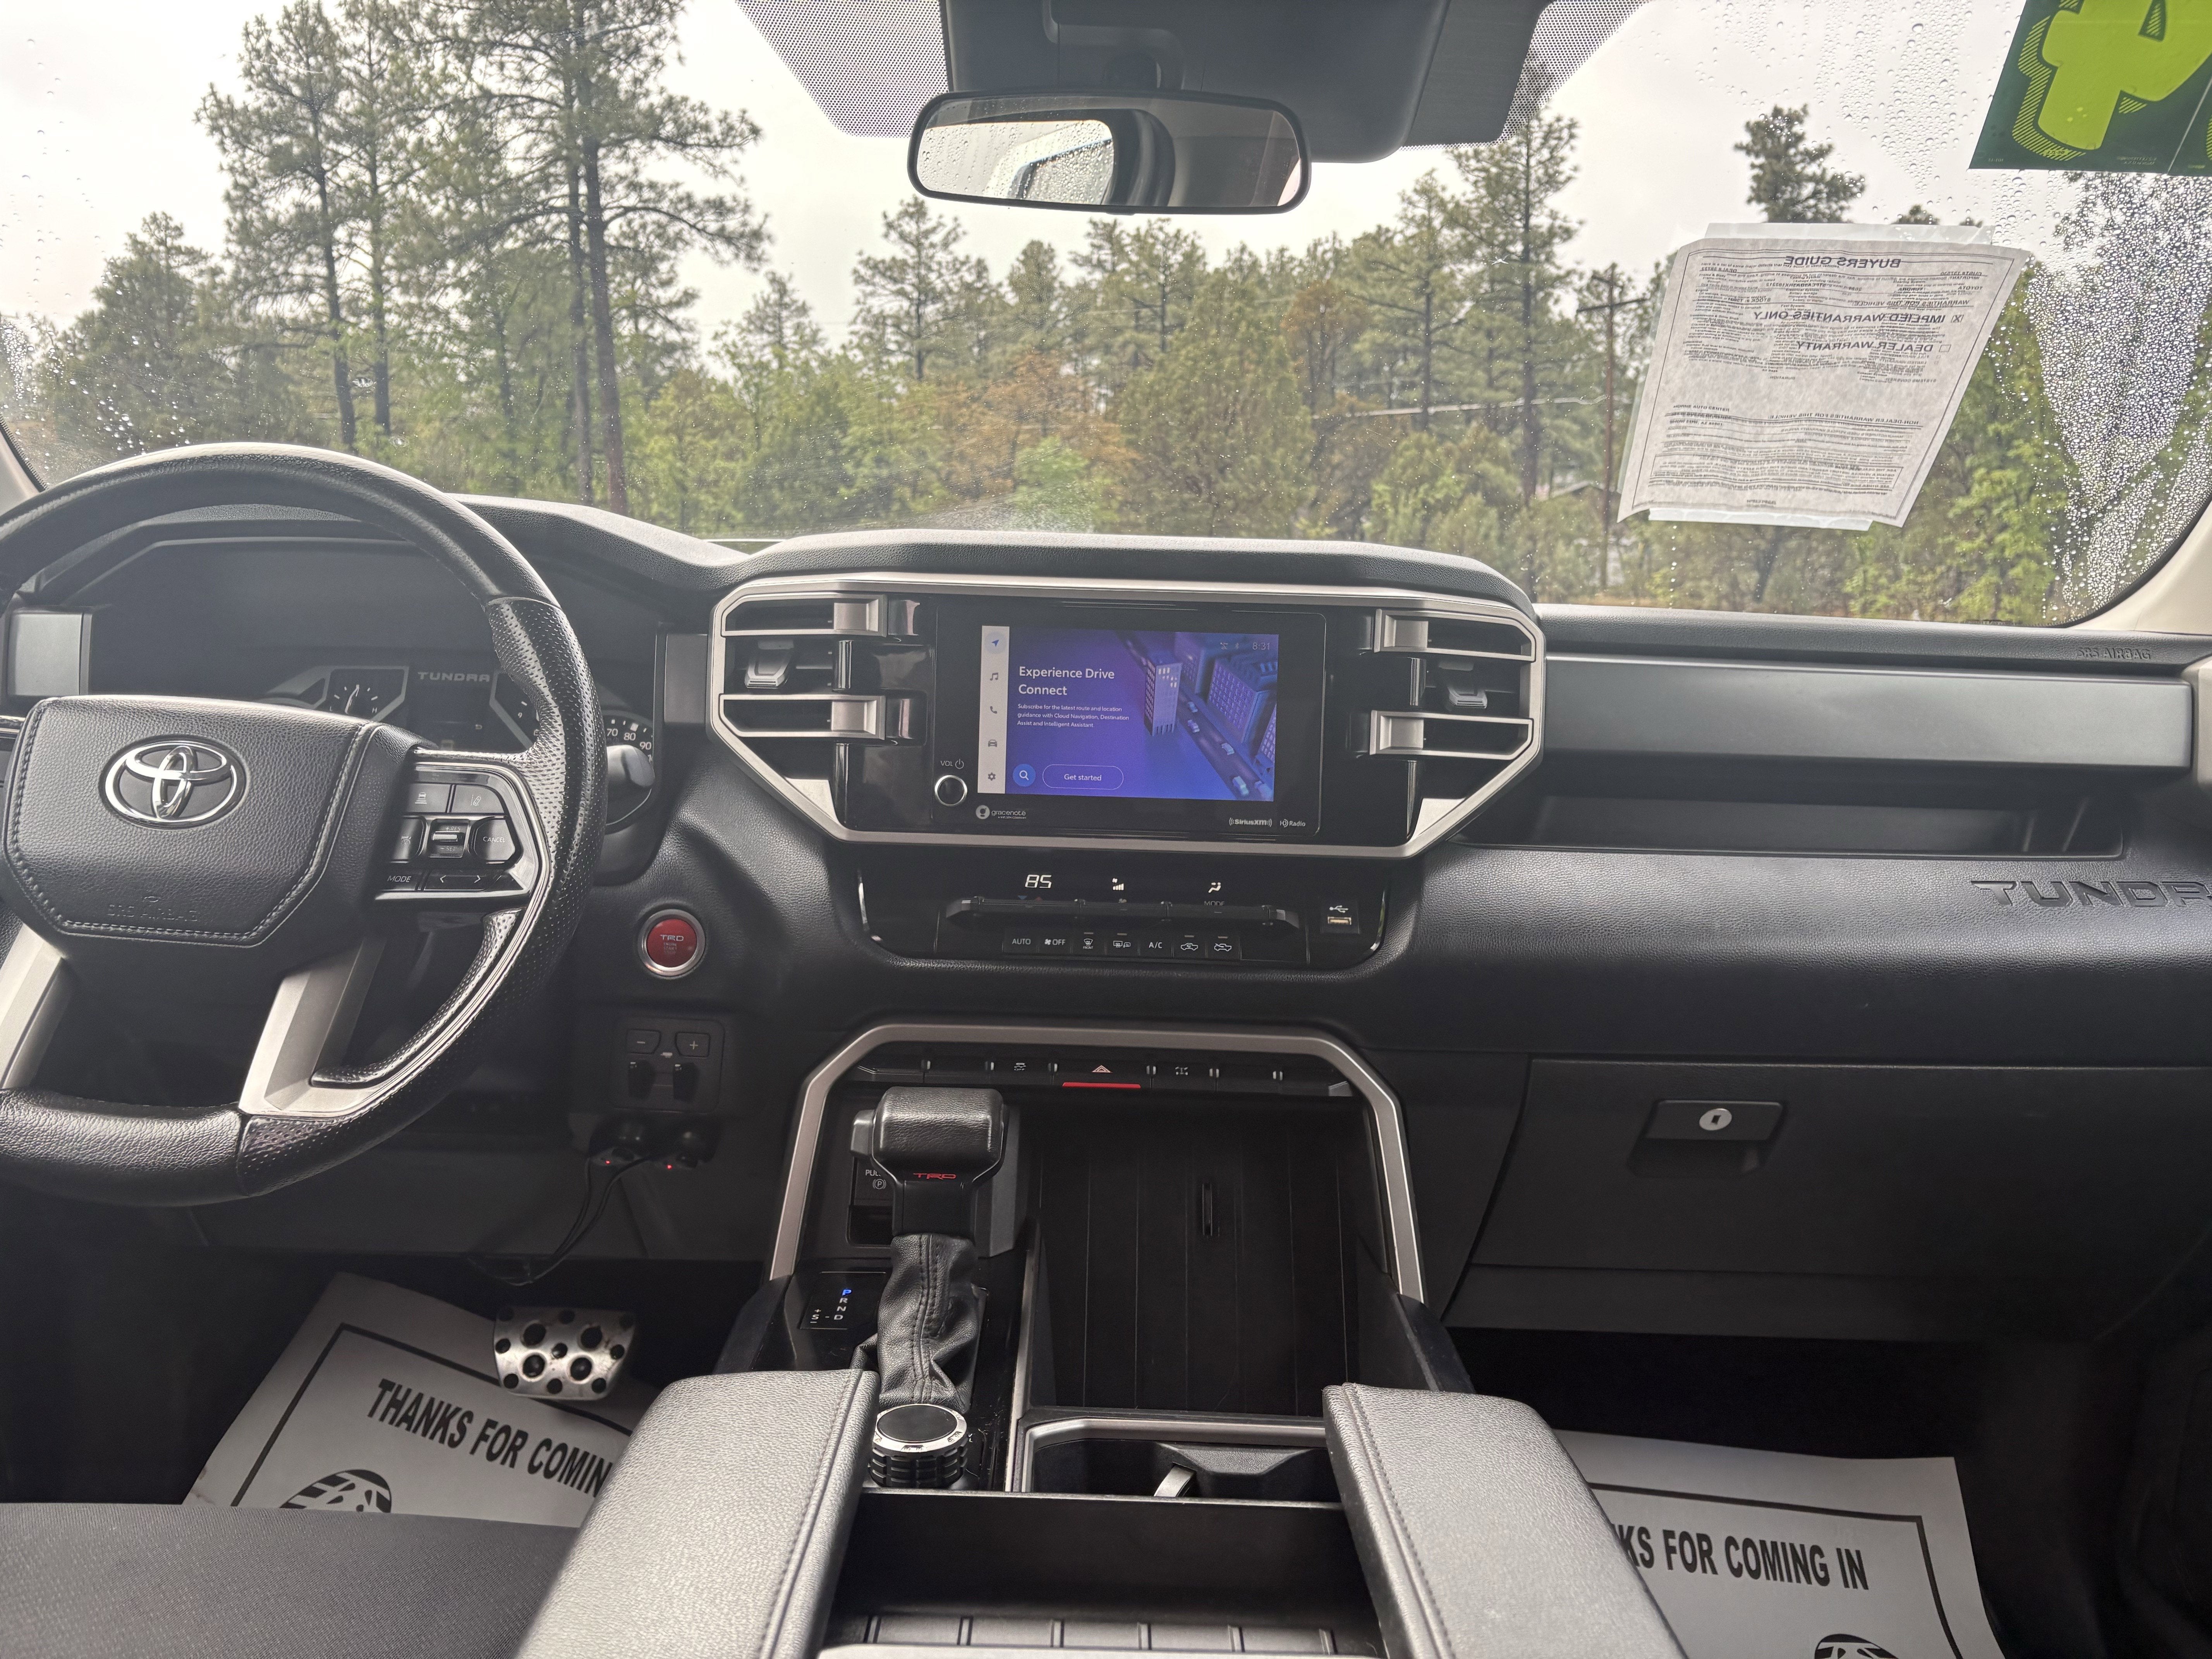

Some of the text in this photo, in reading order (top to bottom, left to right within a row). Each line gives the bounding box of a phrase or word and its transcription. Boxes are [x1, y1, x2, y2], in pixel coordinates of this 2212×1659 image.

[1252, 642, 1270, 651] 8:31
[2078, 647, 2151, 660] SRS AIRBAG
[418, 672, 490, 682] TUNDRA
[1019, 666, 1115, 679] Experience Drive
[1018, 684, 1068, 696] Connect
[606, 728, 618, 737] 70
[623, 733, 636, 741] 80
[639, 742, 652, 750] 90
[1025, 874, 1052, 889] 85
[1971, 881, 2212, 907] TUNDR
[367, 1378, 613, 1498] THANKS FOR COMIN
[1662, 1529, 1719, 1575] FOR
[1724, 1535, 1830, 1587] COMING
[1836, 1547, 1869, 1590] IN
